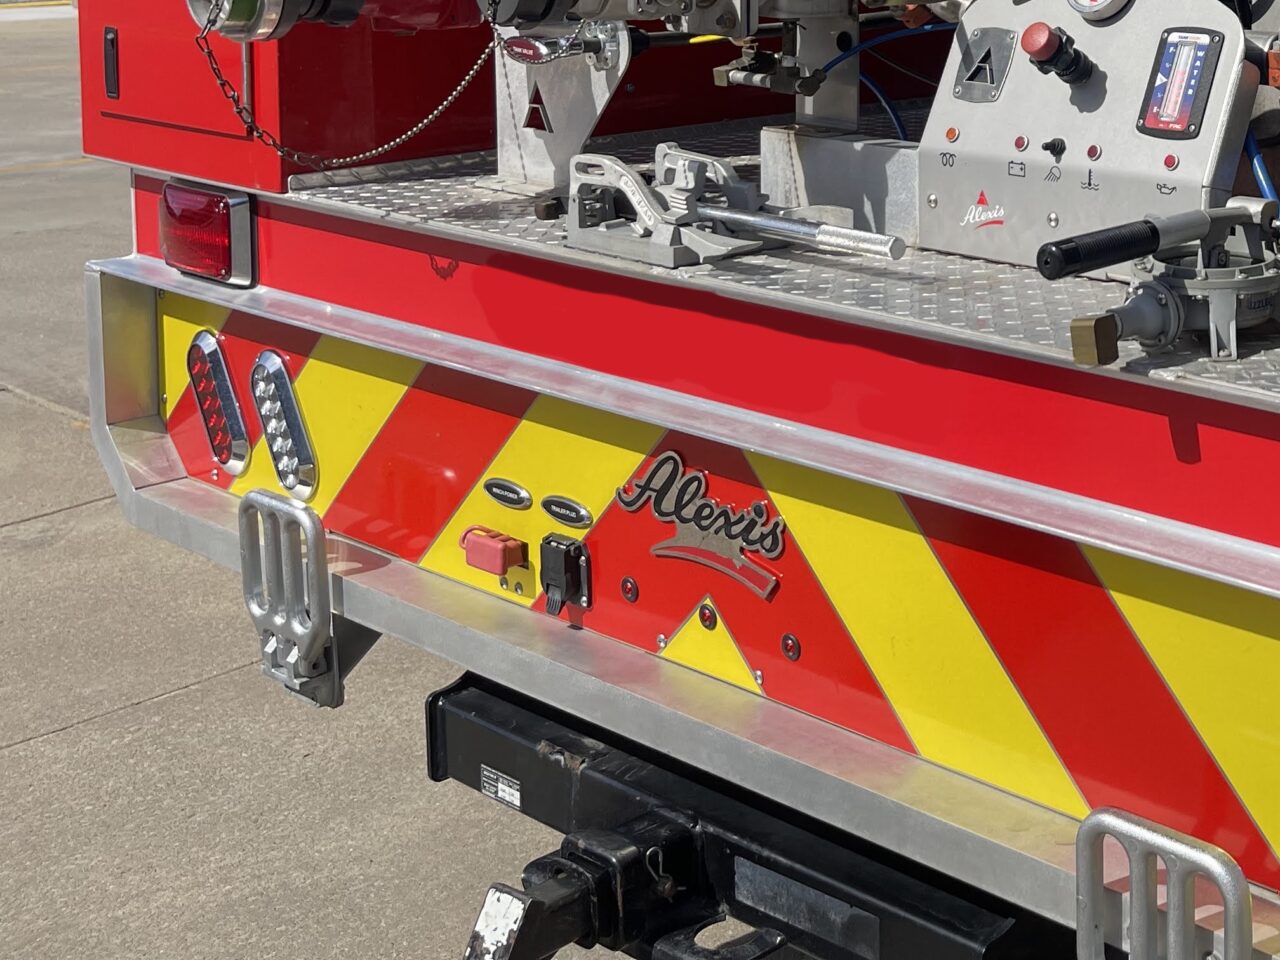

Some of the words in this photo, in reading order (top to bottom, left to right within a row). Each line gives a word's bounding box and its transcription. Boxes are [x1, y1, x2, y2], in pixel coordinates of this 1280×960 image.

[1187, 50, 1206, 95] WATER
[959, 204, 1005, 226] Alexis
[617, 454, 782, 556] Alexis
